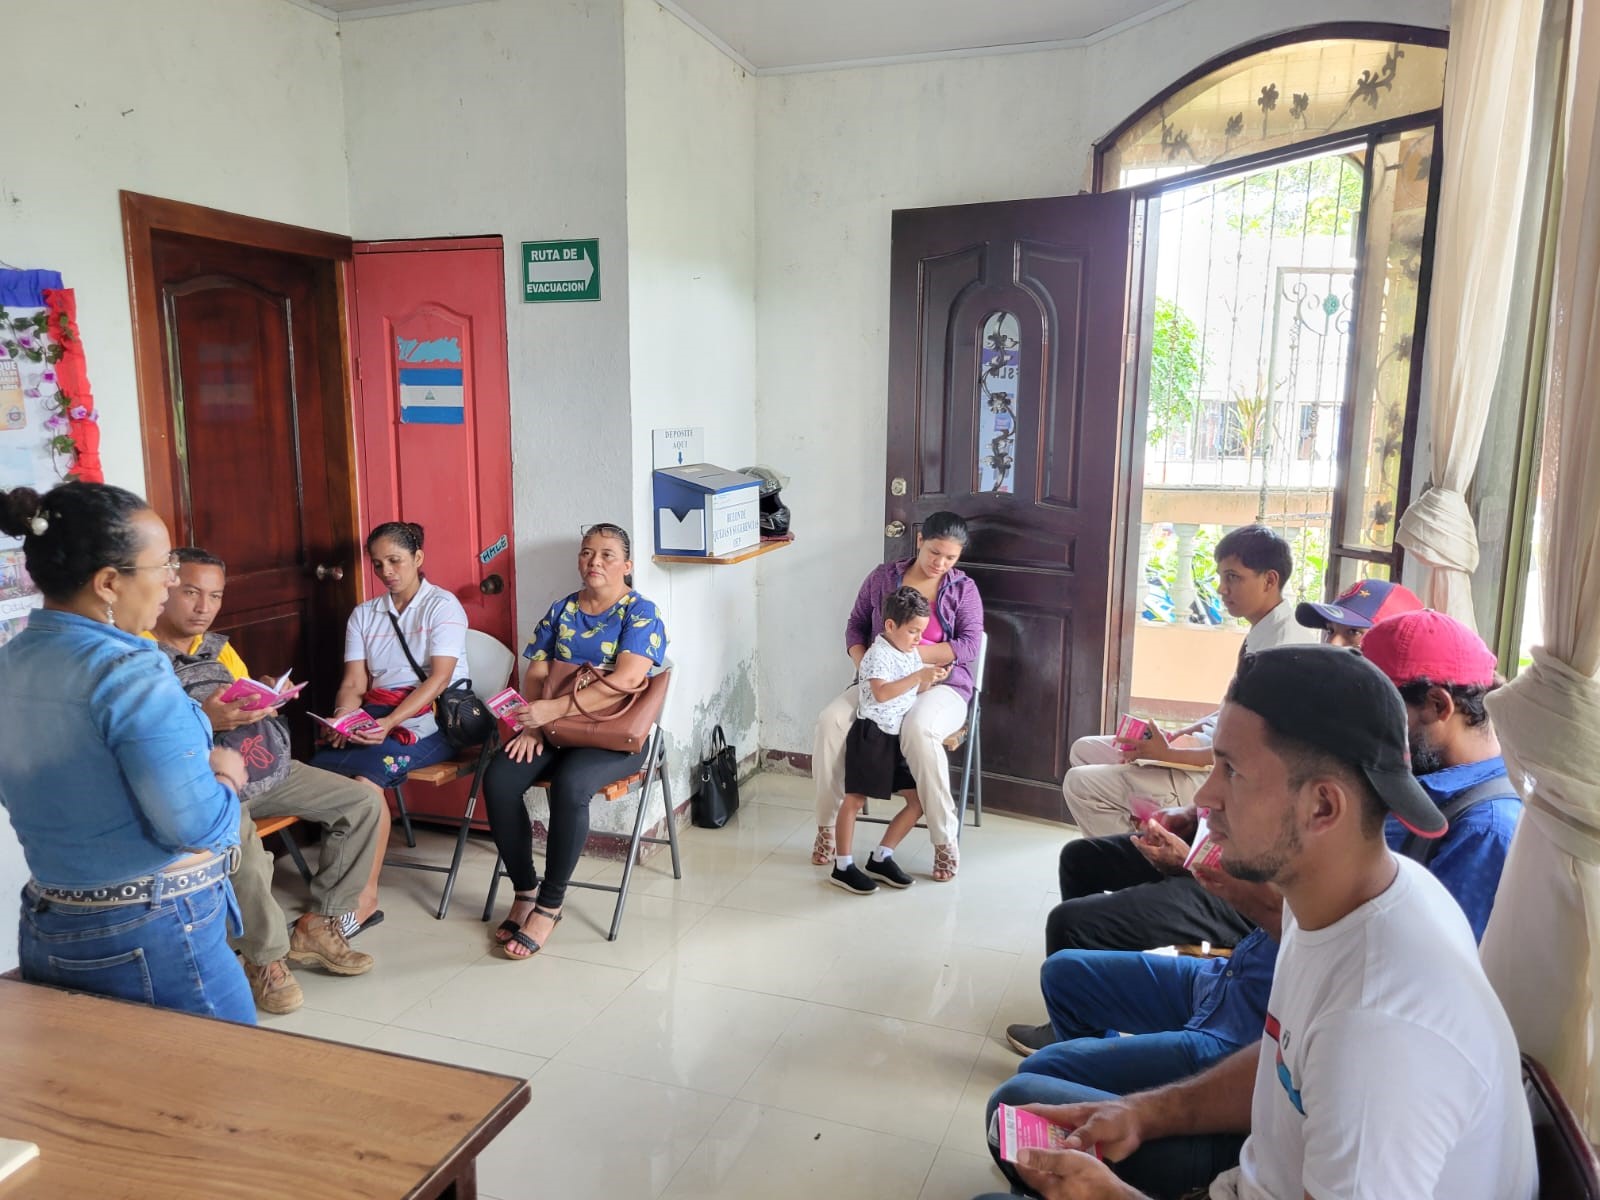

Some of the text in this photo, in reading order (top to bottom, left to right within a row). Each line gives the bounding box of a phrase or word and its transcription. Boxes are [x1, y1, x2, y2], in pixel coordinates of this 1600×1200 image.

[531, 248, 578, 261] RUTA DE
[526, 282, 585, 293] EVACUACION
